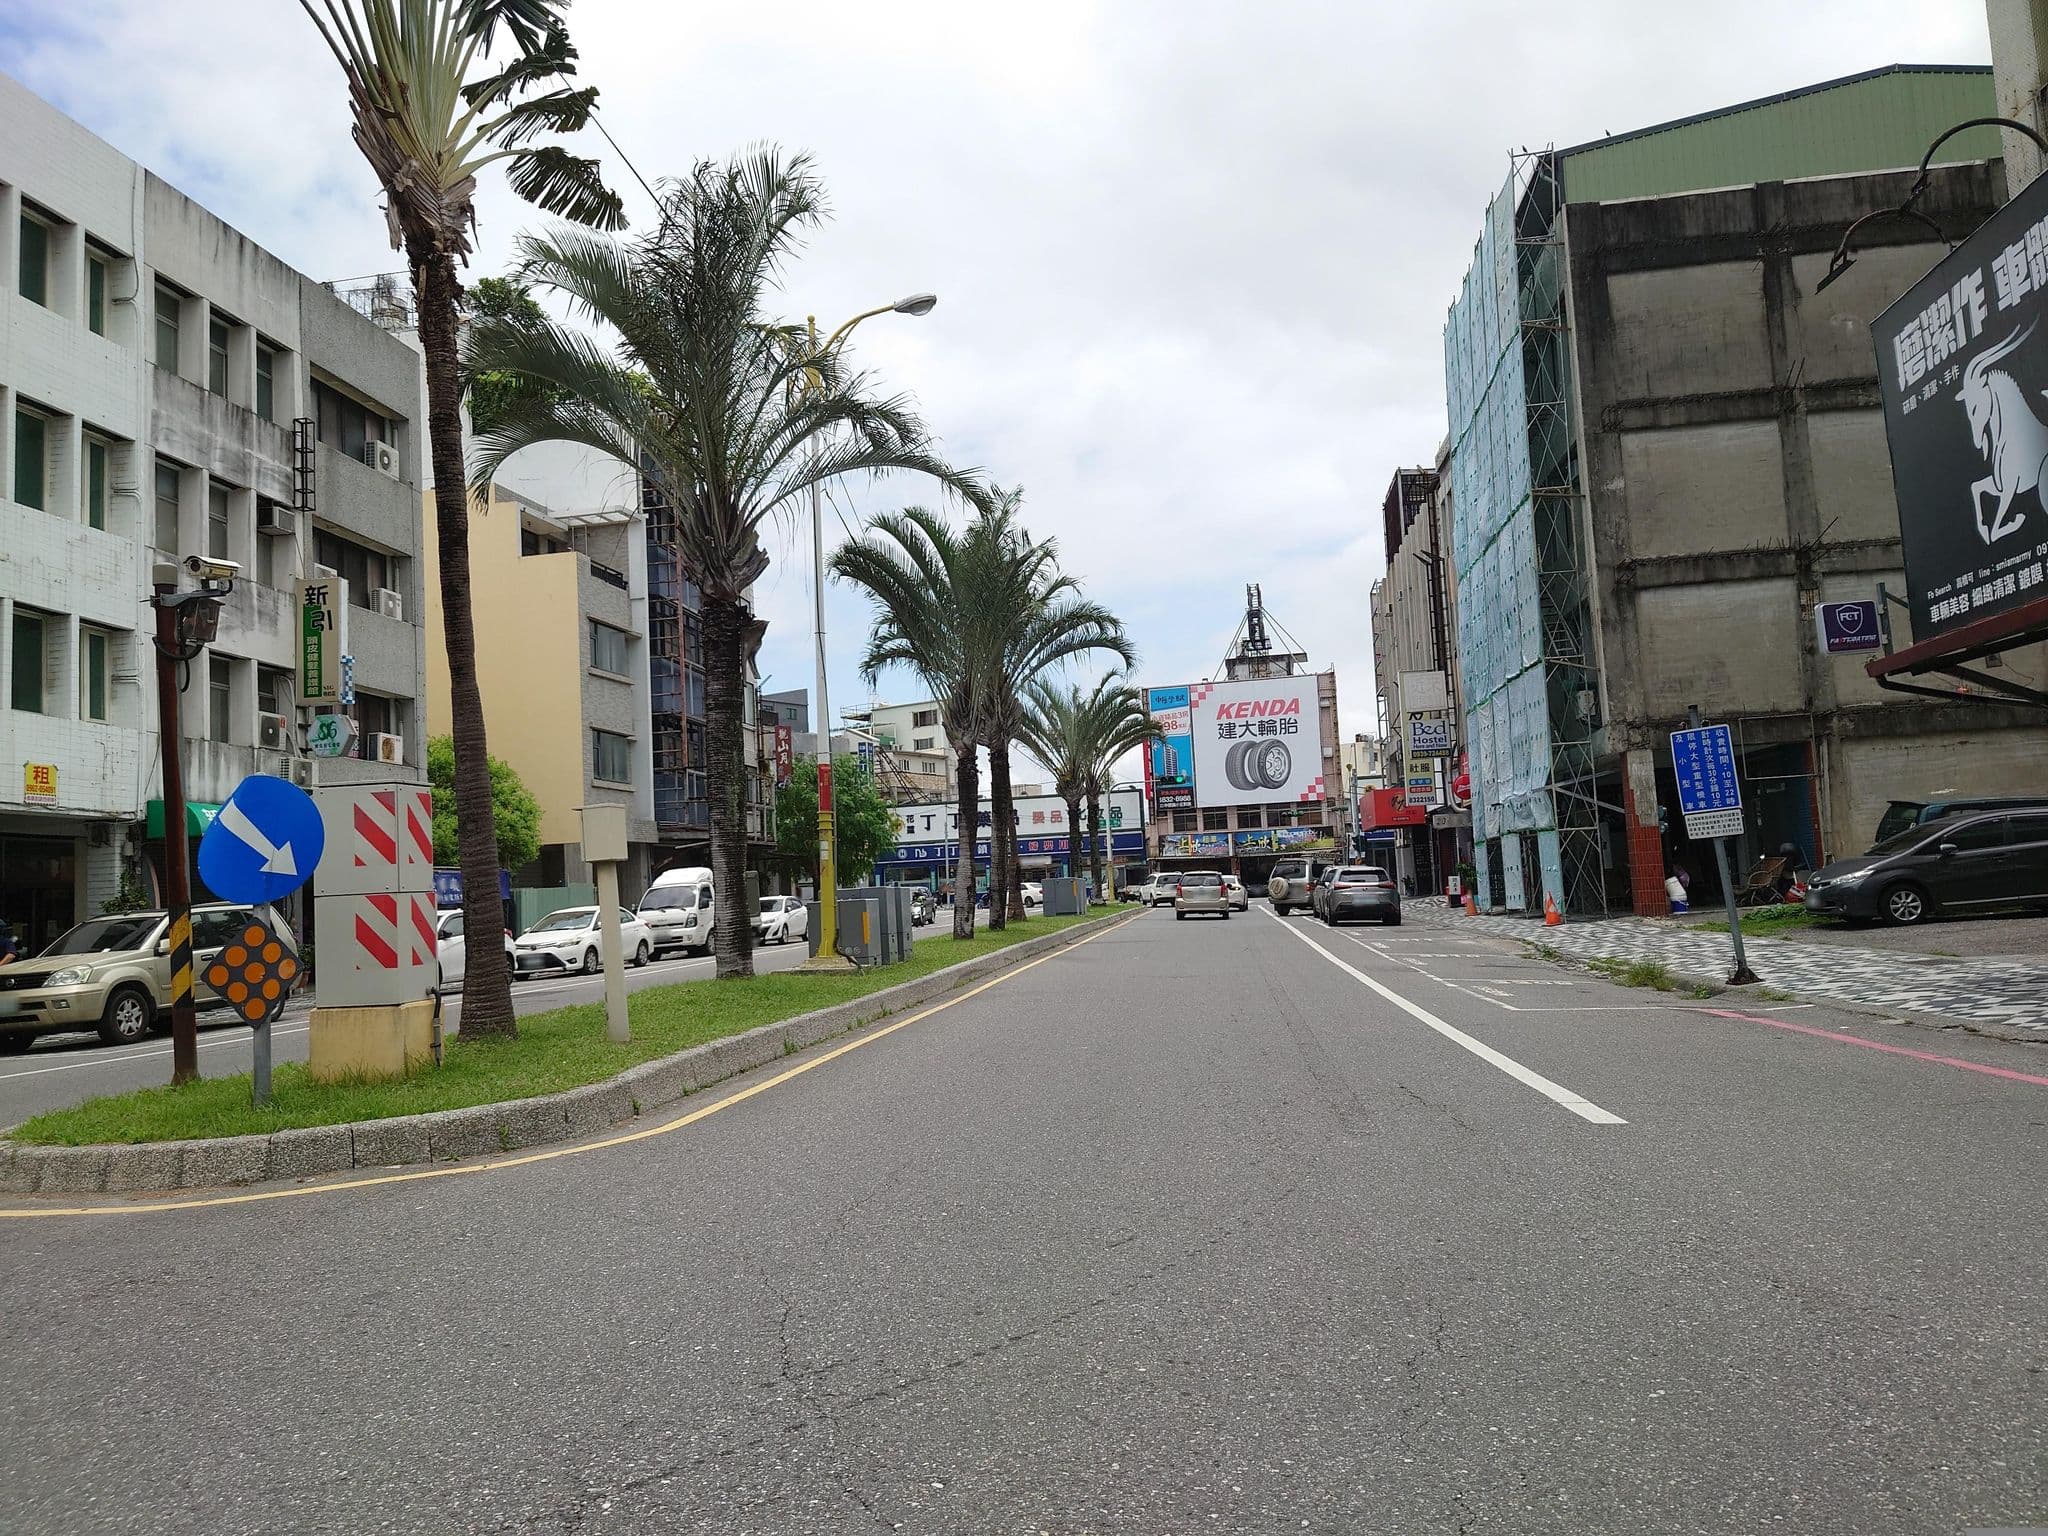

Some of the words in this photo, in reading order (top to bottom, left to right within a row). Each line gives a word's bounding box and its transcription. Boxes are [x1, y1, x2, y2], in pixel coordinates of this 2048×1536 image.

[304, 584, 333, 632] 新引
[1929, 592, 1970, 623] 車輛美容
[1971, 573, 2016, 608] 細緻清潔
[1216, 698, 1300, 721] KENDA
[1217, 717, 1298, 740] 建大輪胎
[1411, 720, 1447, 736] Bed
[1413, 735, 1447, 744] Hostel
[33, 765, 50, 785] 租
